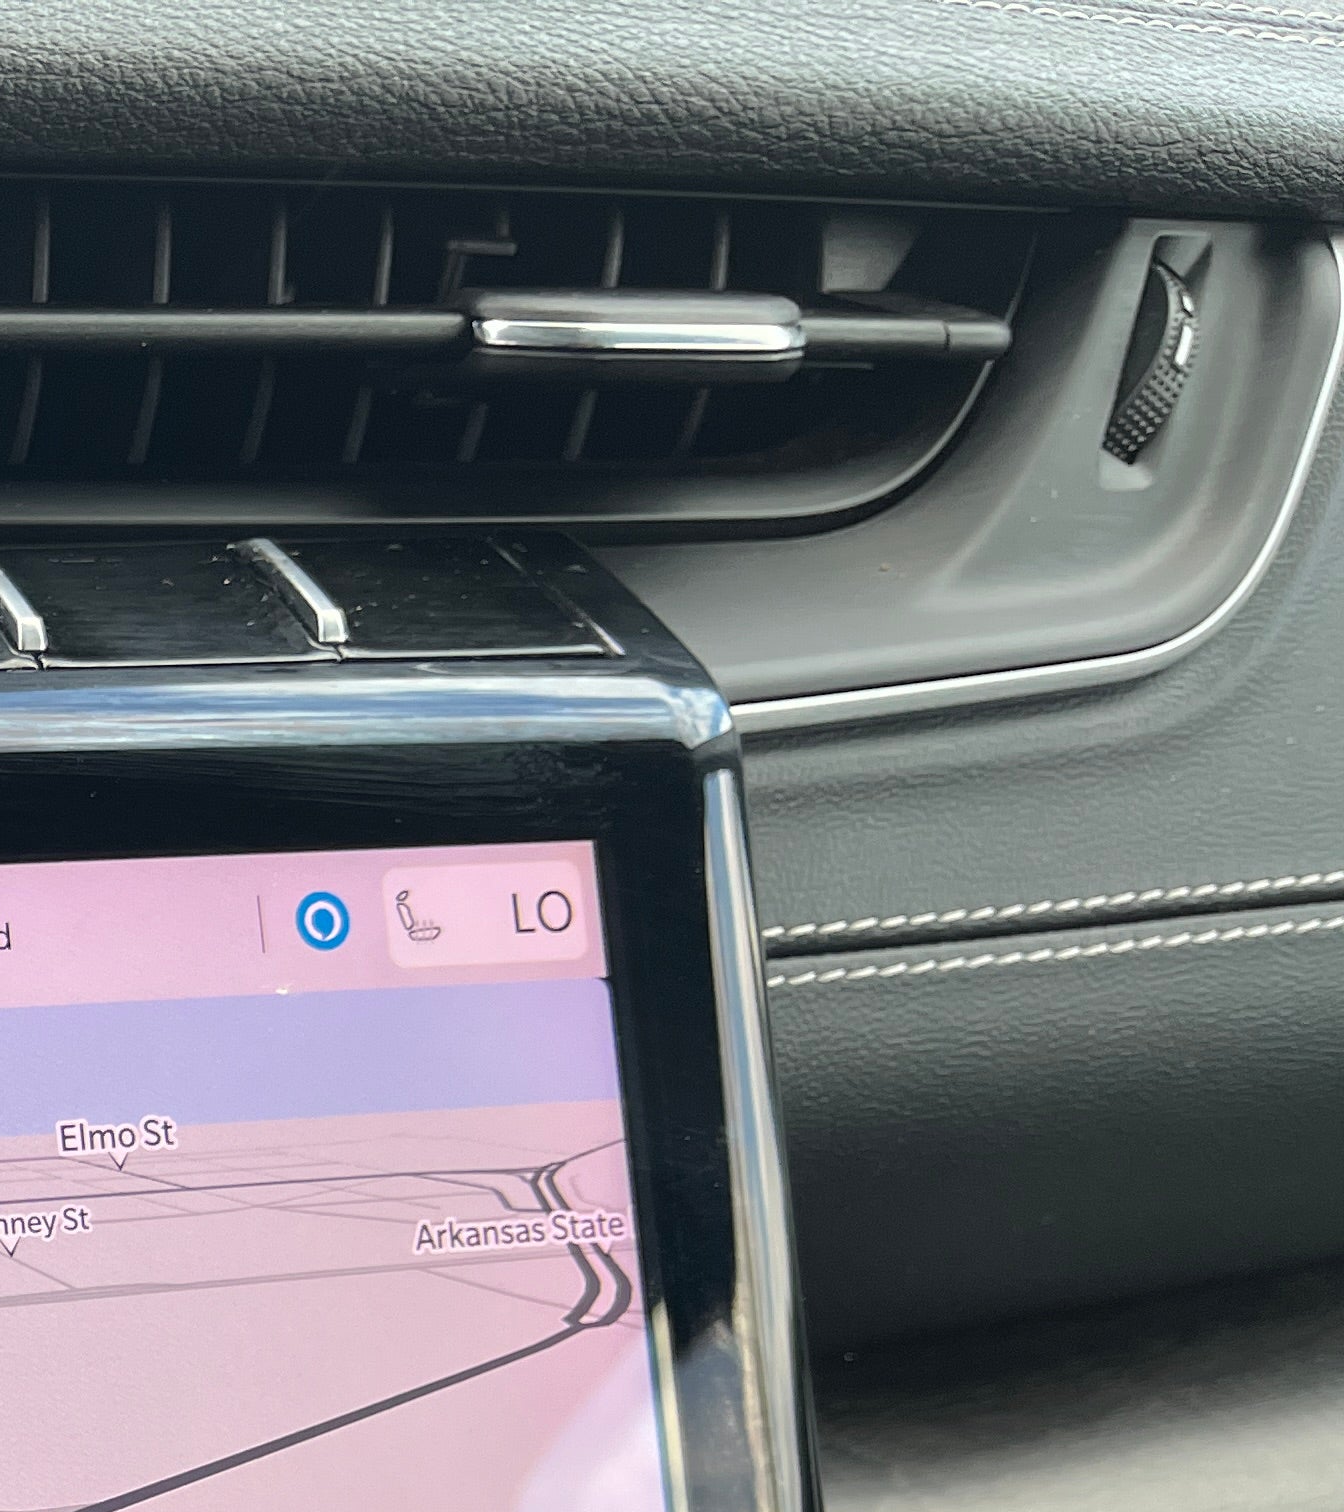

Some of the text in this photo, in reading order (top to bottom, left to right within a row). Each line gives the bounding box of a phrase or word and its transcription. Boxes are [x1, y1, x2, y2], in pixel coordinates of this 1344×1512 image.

[510, 890, 573, 935] LO
[59, 1119, 175, 1152] Elmo St
[63, 1207, 91, 1231] St
[416, 1213, 625, 1251] Arkansas State
